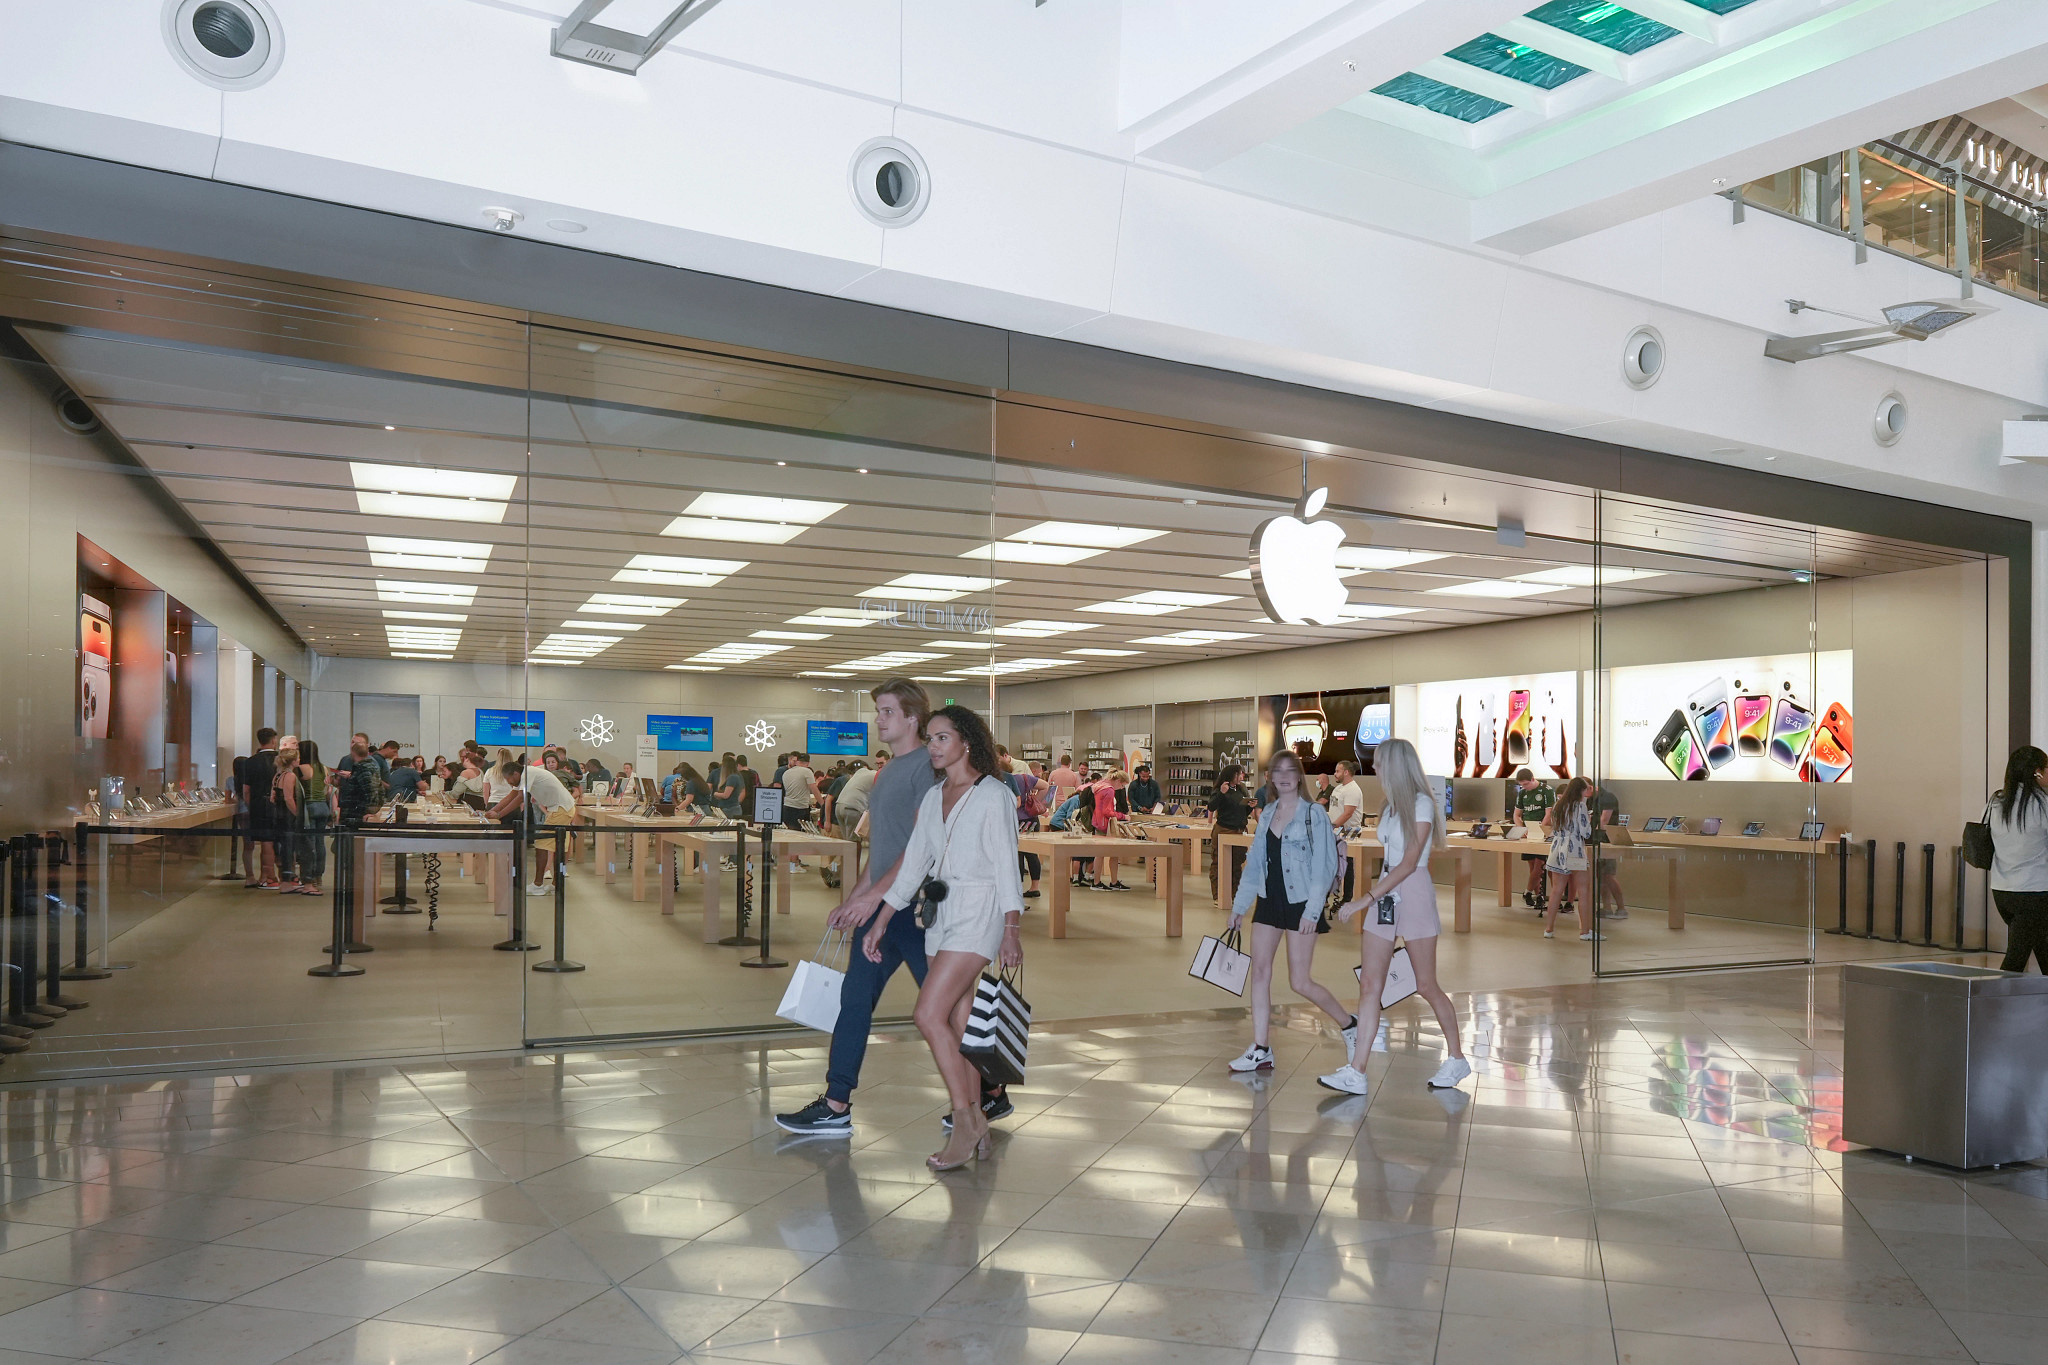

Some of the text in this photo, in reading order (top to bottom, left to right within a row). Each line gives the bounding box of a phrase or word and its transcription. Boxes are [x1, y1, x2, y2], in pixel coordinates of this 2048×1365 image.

[1967, 138, 2004, 175] TED
[1744, 709, 1760, 717] 9:41
[1623, 719, 1648, 728] iPhone 14
[1706, 719, 1721, 732] 9:41
[1784, 716, 1802, 730] 9:41
[1676, 747, 1689, 765] 9:41
[1822, 745, 1837, 764] 9:41
